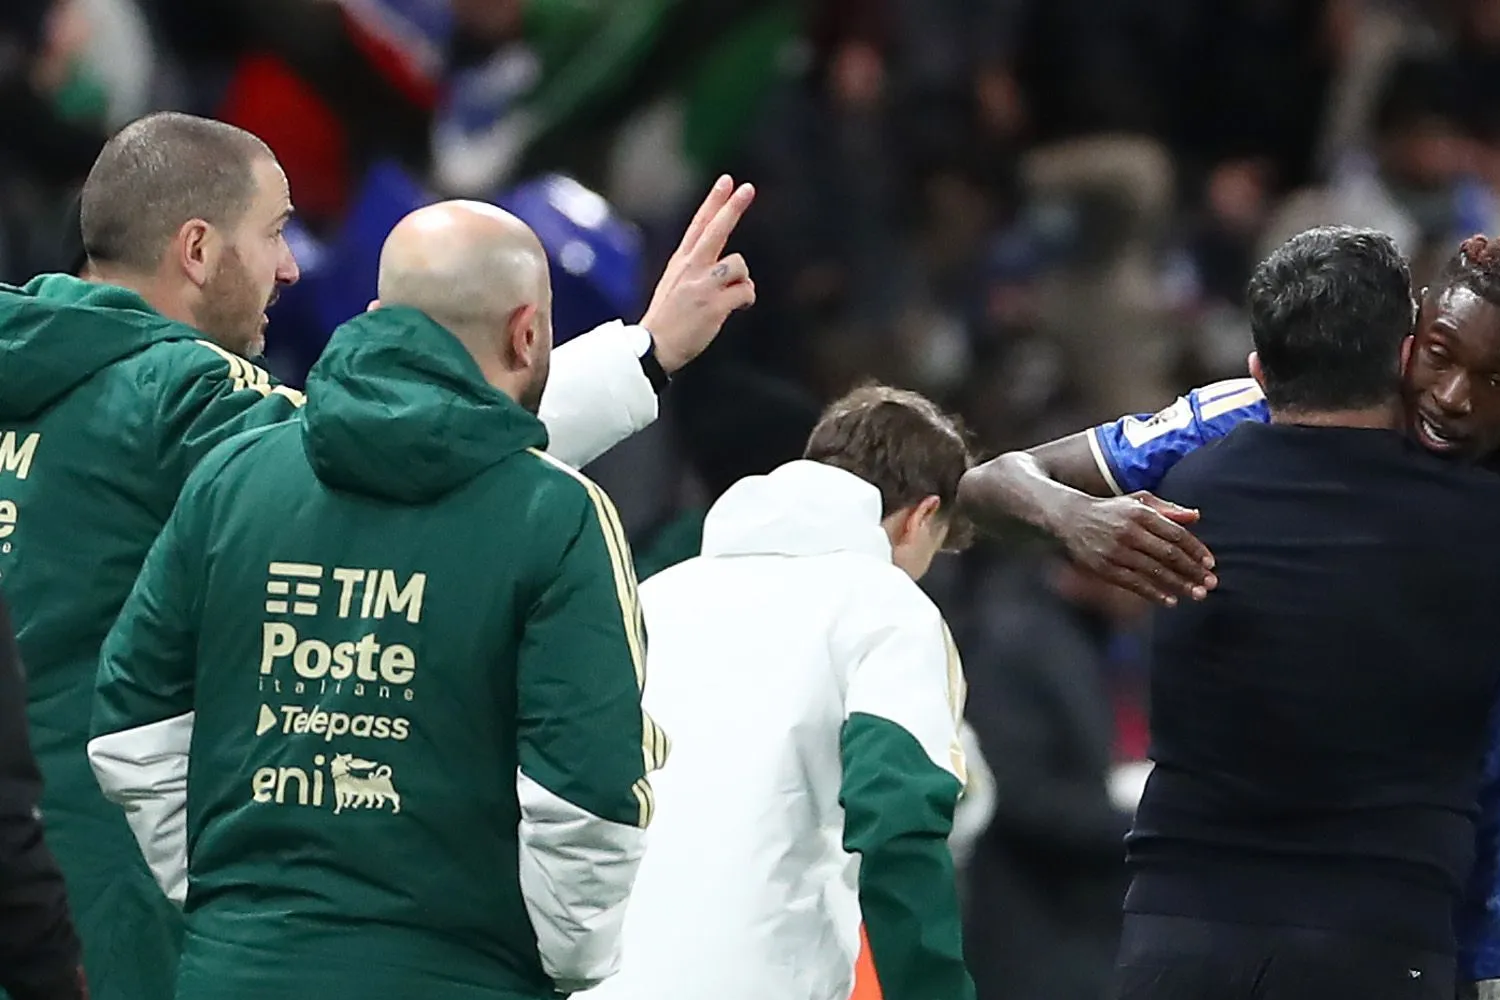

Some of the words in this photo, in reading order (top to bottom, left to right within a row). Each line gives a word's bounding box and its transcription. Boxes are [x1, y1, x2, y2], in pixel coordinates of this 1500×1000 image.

[333, 567, 427, 624] TIM
[260, 621, 416, 685] Poste
[258, 676, 415, 701] italiane
[280, 704, 410, 742] Telepass
[252, 754, 325, 807] eni
